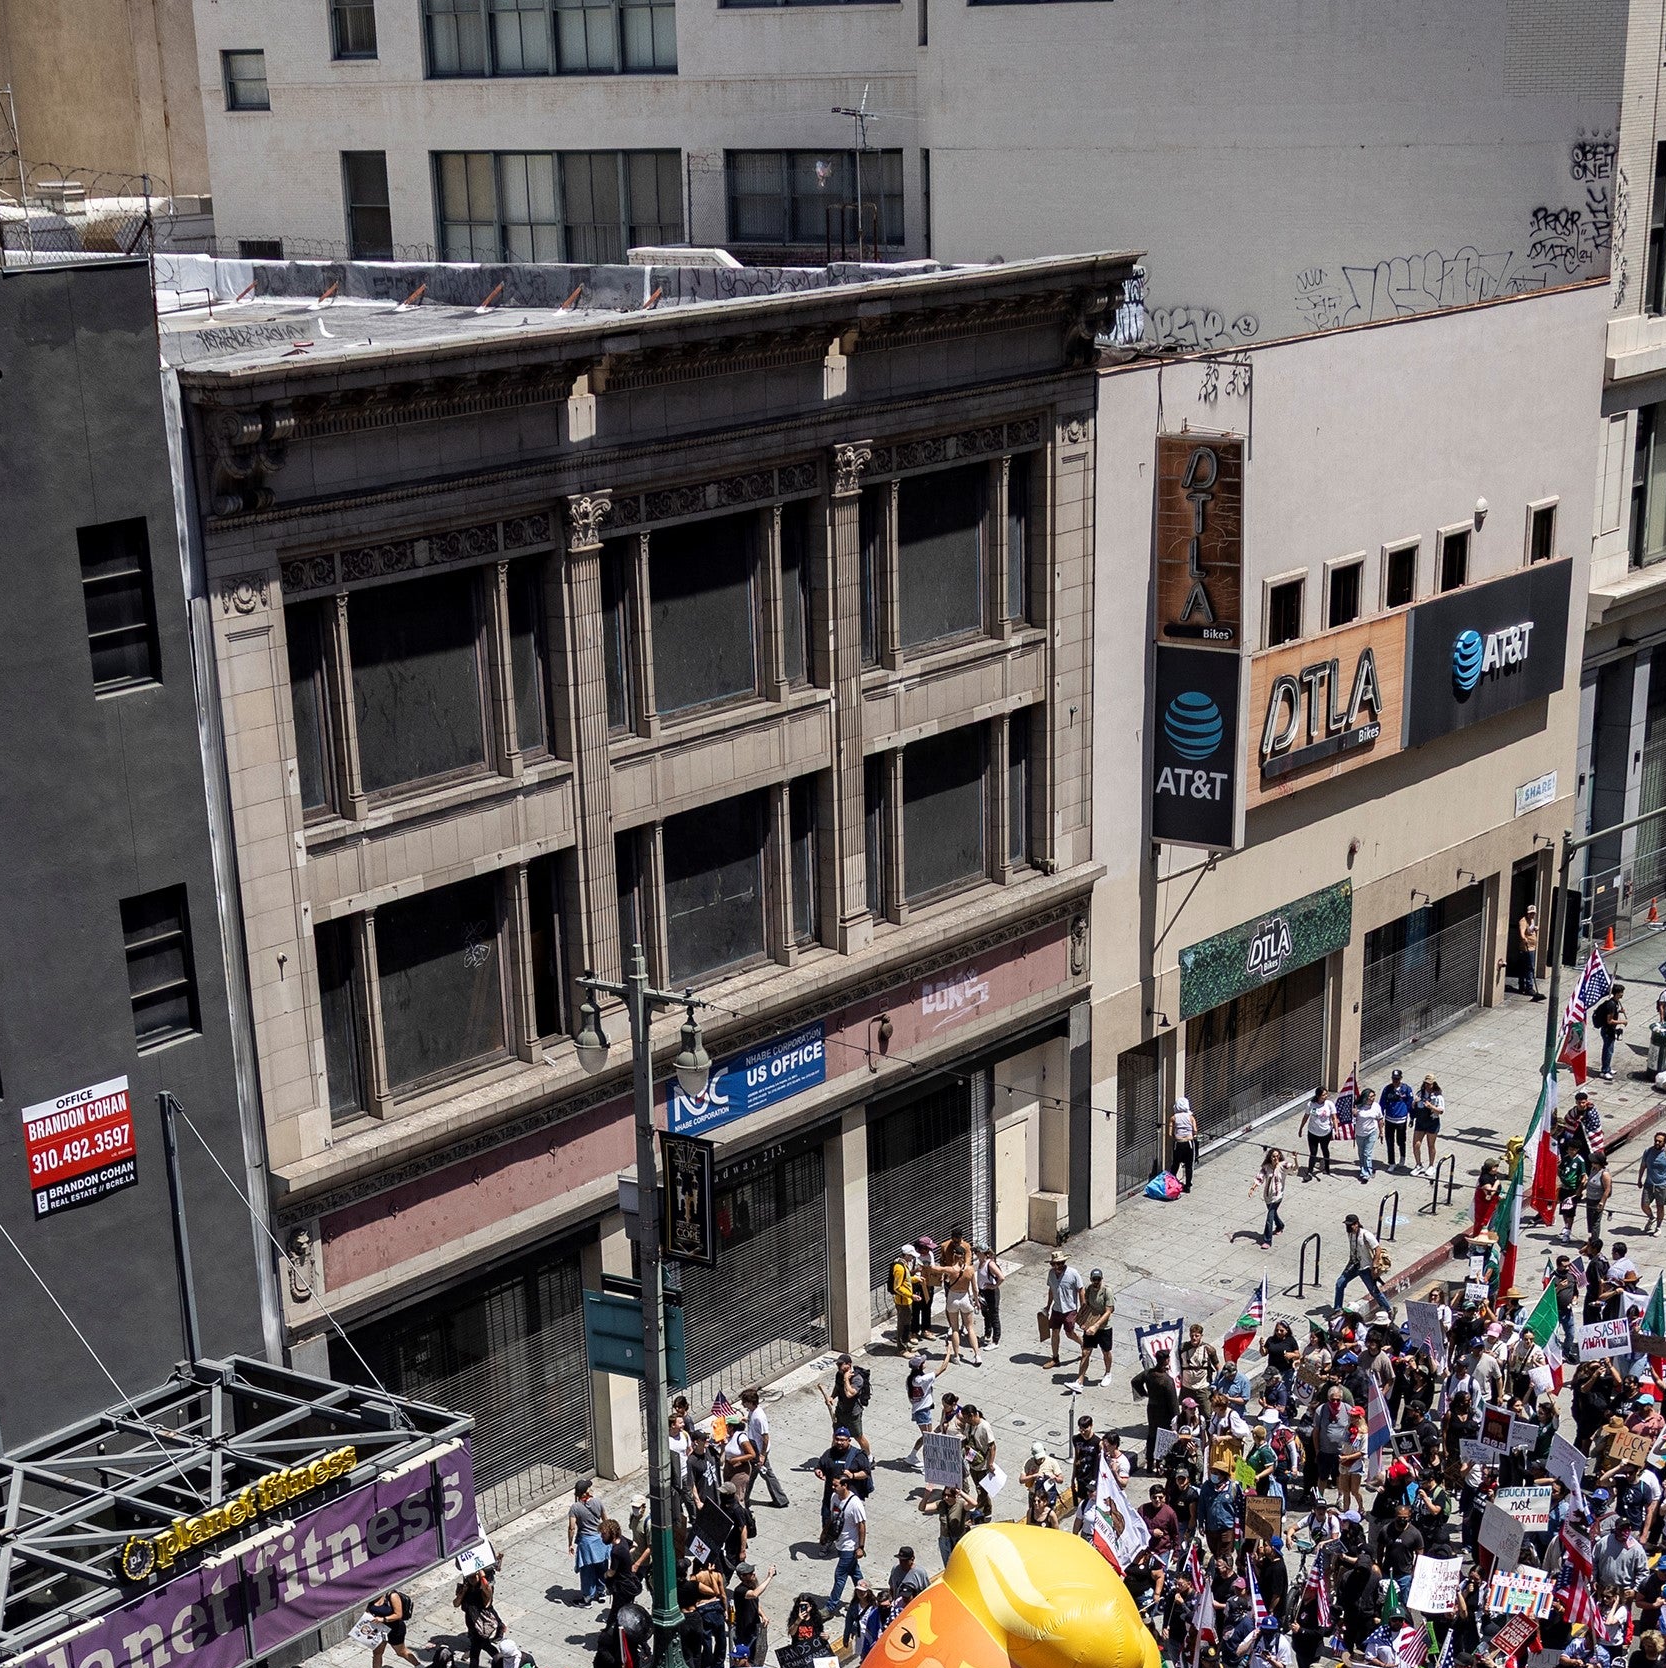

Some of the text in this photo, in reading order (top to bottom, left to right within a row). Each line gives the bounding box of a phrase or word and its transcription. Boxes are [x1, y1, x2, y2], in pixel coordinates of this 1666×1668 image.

[1202, 626, 1230, 642] Bikes
[1481, 620, 1534, 673] AT&T
[1260, 647, 1384, 756] DTLA
[1357, 722, 1381, 743] Bikes
[1155, 766, 1229, 801] AT&T
[745, 1027, 822, 1067] NHABE CORPORATION
[746, 1040, 823, 1087] US OFFICE
[28, 1093, 127, 1142] BRANDON COHAN
[56, 1089, 93, 1109] OFFICE
[674, 1106, 730, 1133] NHABE CORPORATION
[32, 1124, 130, 1174] 310.492.3597
[49, 1161, 134, 1199] BRANDON COHAN
[50, 1173, 135, 1209] REAL ESTATE BCRE.LA
[1617, 1432, 1648, 1450] FUCK
[1617, 1445, 1638, 1459] ICE
[154, 1444, 358, 1569] planet fitness
[1499, 1486, 1551, 1501] EDUCATION
[243, 1469, 465, 1606] fitness
